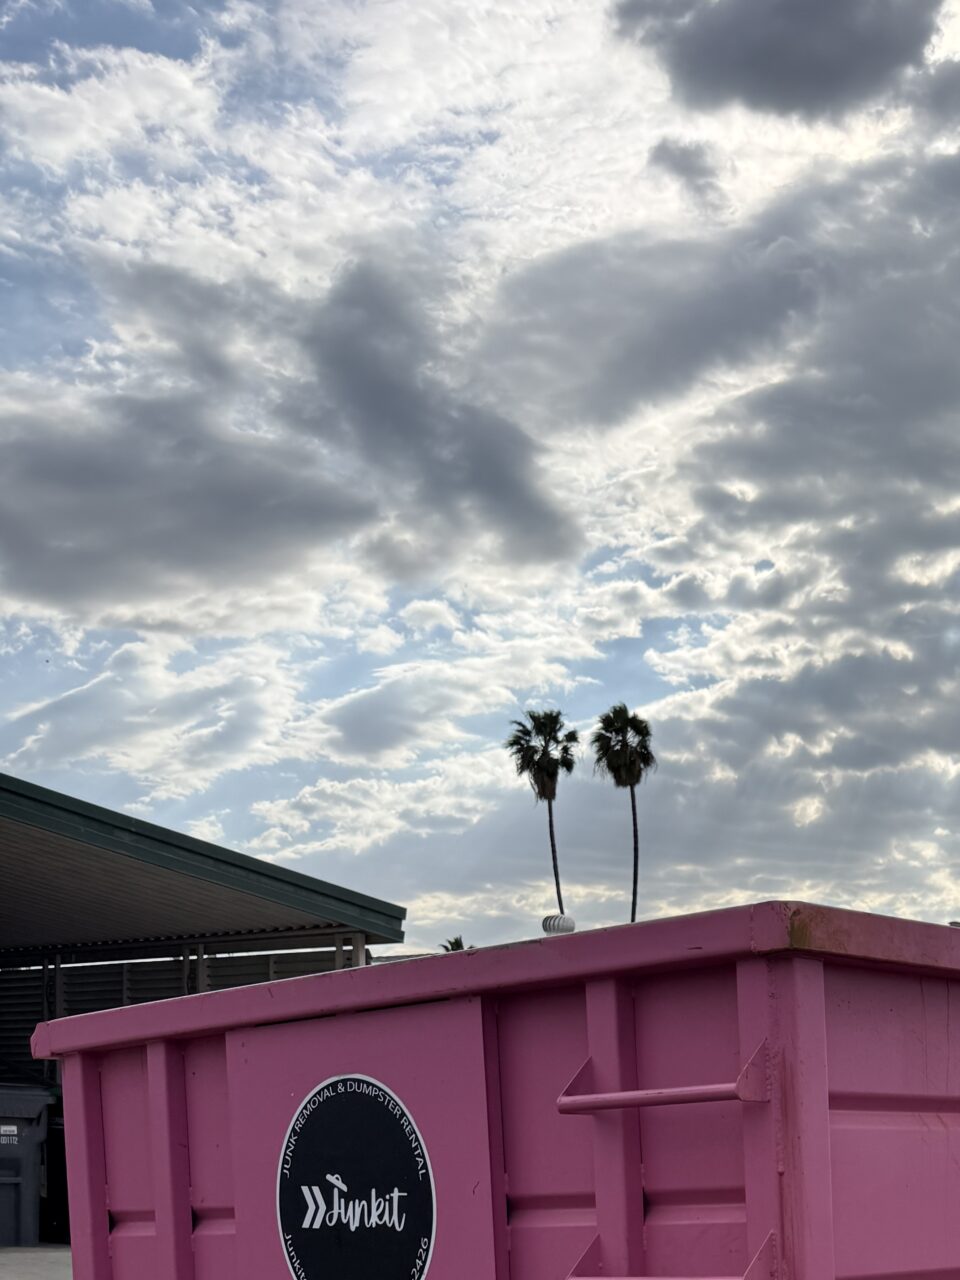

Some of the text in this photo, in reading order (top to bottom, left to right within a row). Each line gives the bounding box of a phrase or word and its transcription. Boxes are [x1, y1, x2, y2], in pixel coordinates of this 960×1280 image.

[283, 1081, 426, 1181] JUNK REMOVAL & DUMPSTER RENTAL
[326, 1185, 408, 1232] Junkit
